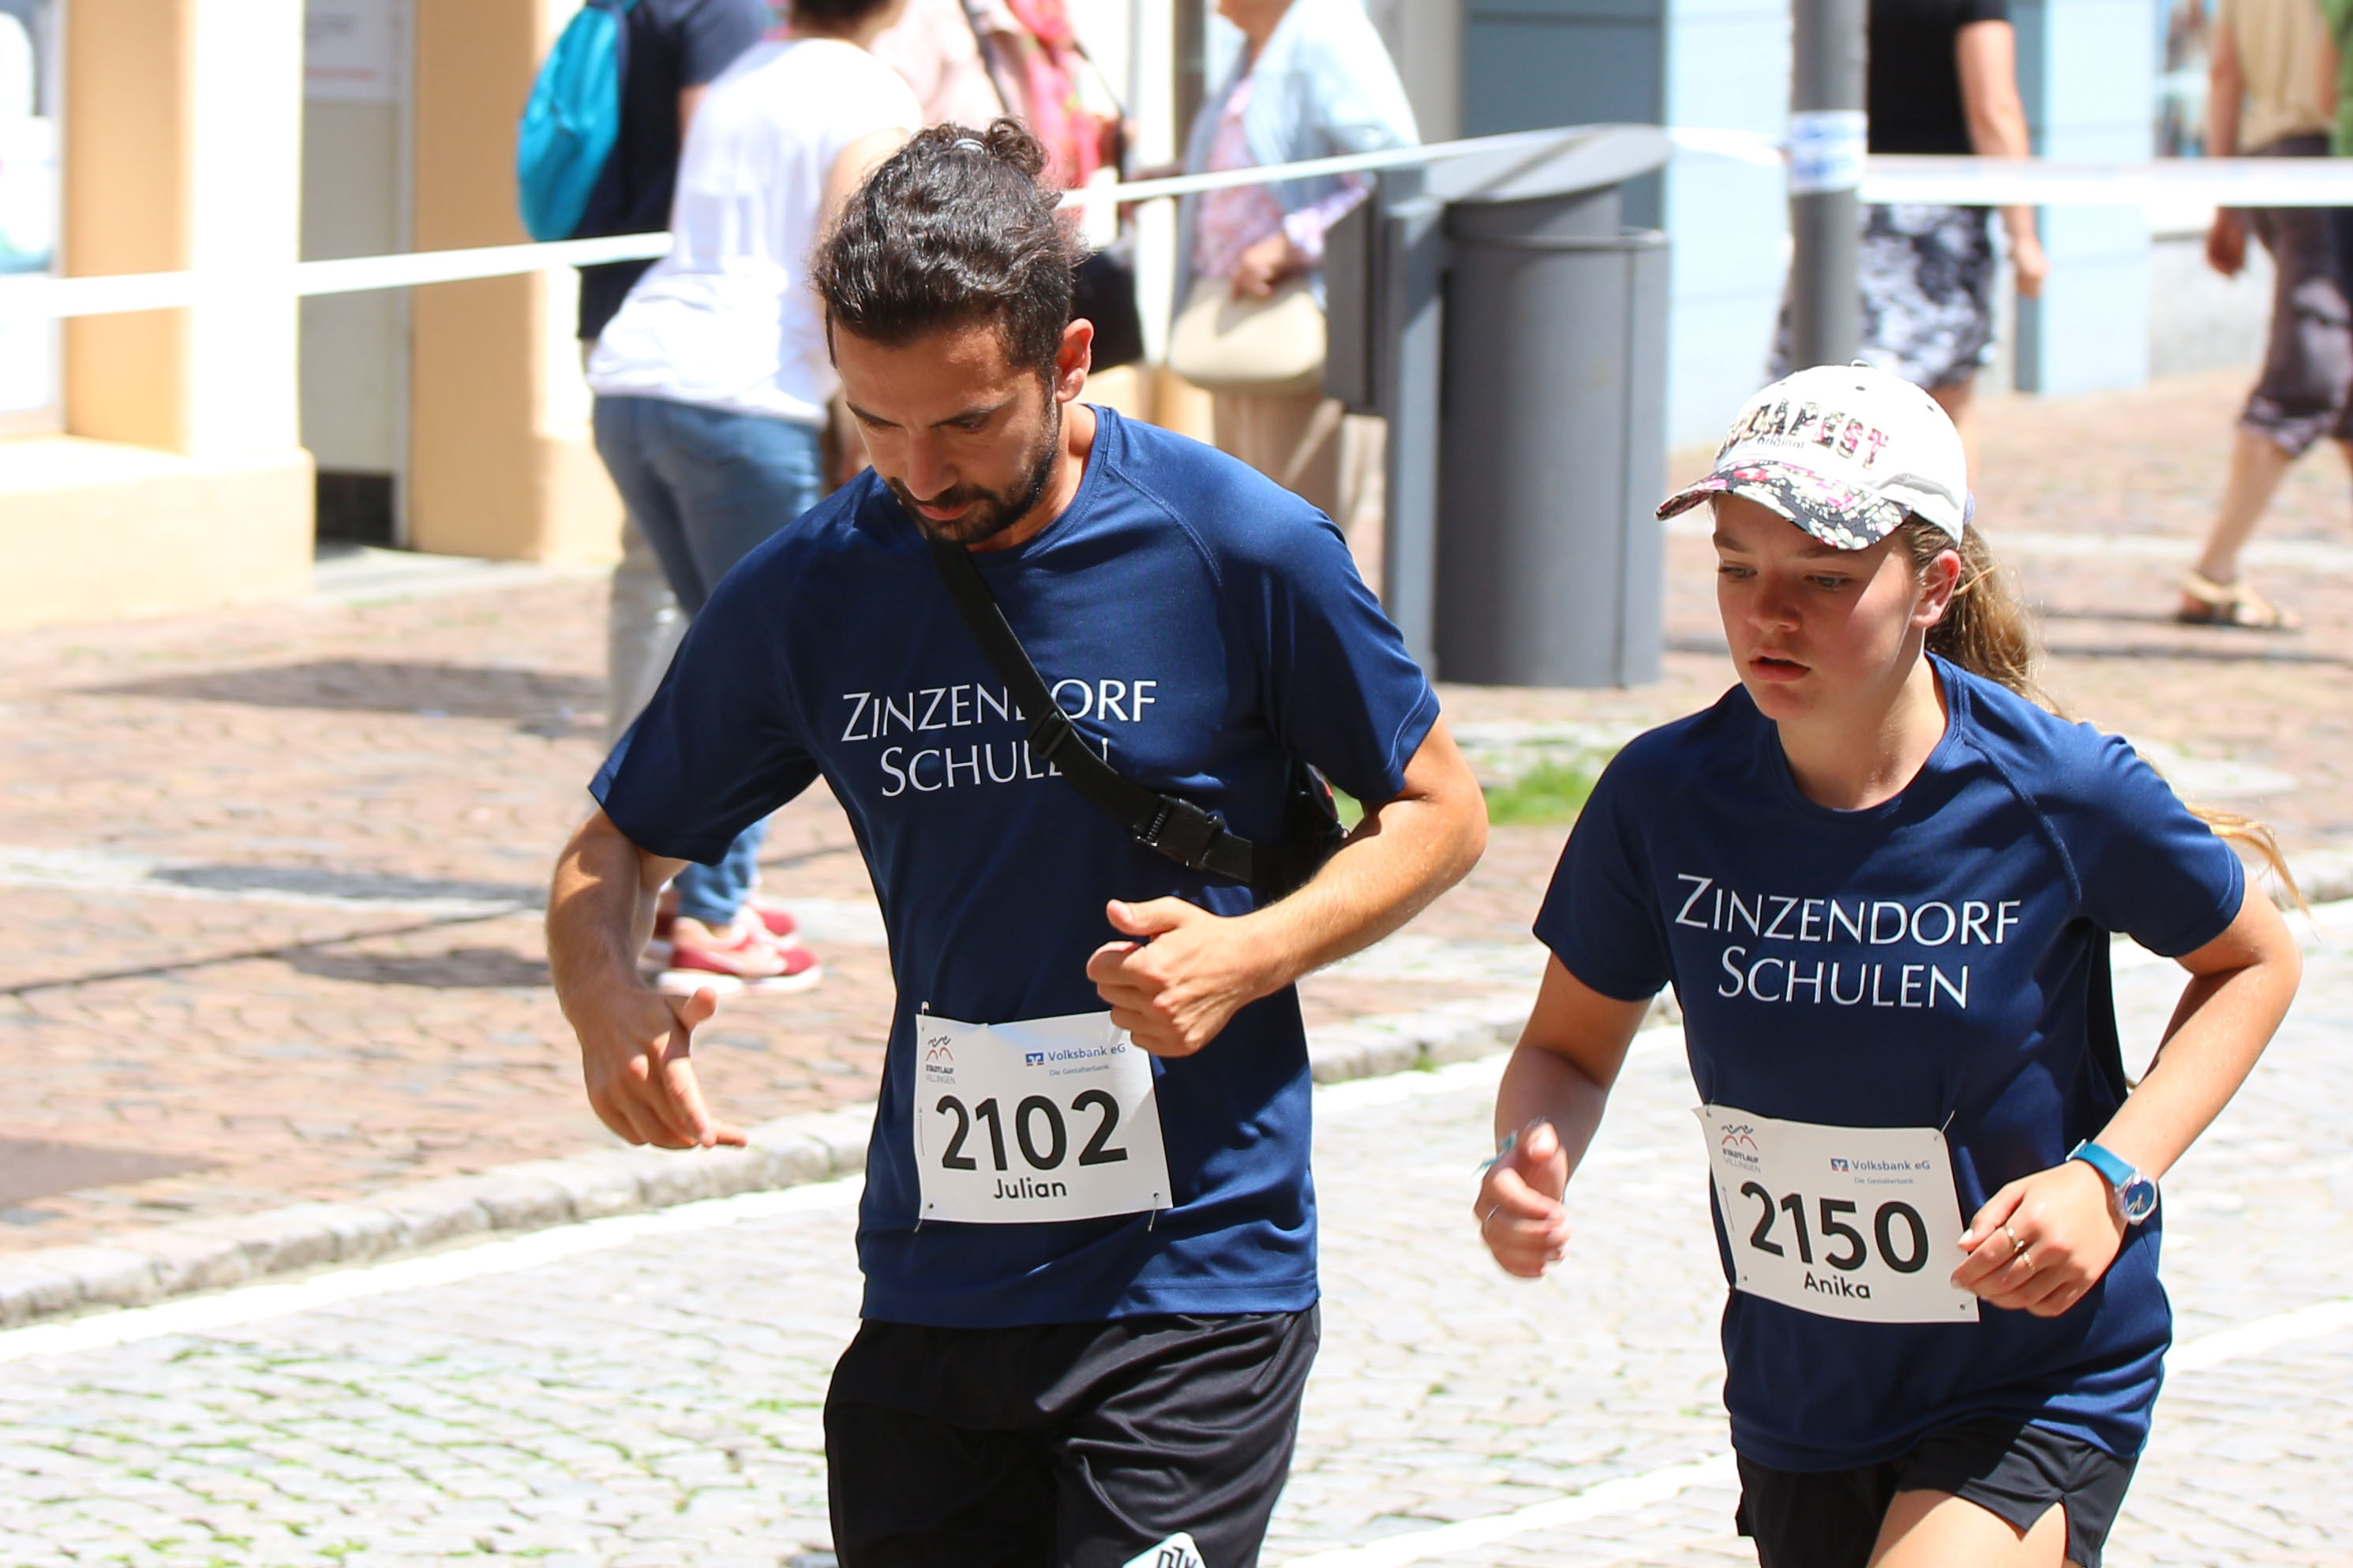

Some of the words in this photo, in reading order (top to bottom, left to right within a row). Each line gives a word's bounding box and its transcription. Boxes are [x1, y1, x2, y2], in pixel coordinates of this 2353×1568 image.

[841, 679, 1158, 742] ZINZENORF
[880, 738, 1110, 797] SCHUL
[1674, 873, 2021, 946] ZINZENDORF
[1718, 945, 1969, 1009] SCHULEN
[1047, 1046, 1108, 1061] Volksbank
[1111, 1042, 1126, 1054] eG
[935, 1089, 1128, 1171] 2102
[993, 1177, 1067, 1199] Julian
[1851, 1159, 1912, 1171] Volksbank
[1914, 1159, 1931, 1170] eG
[1740, 1181, 1929, 1274] 2150
[1804, 1271, 1872, 1300] Anika
